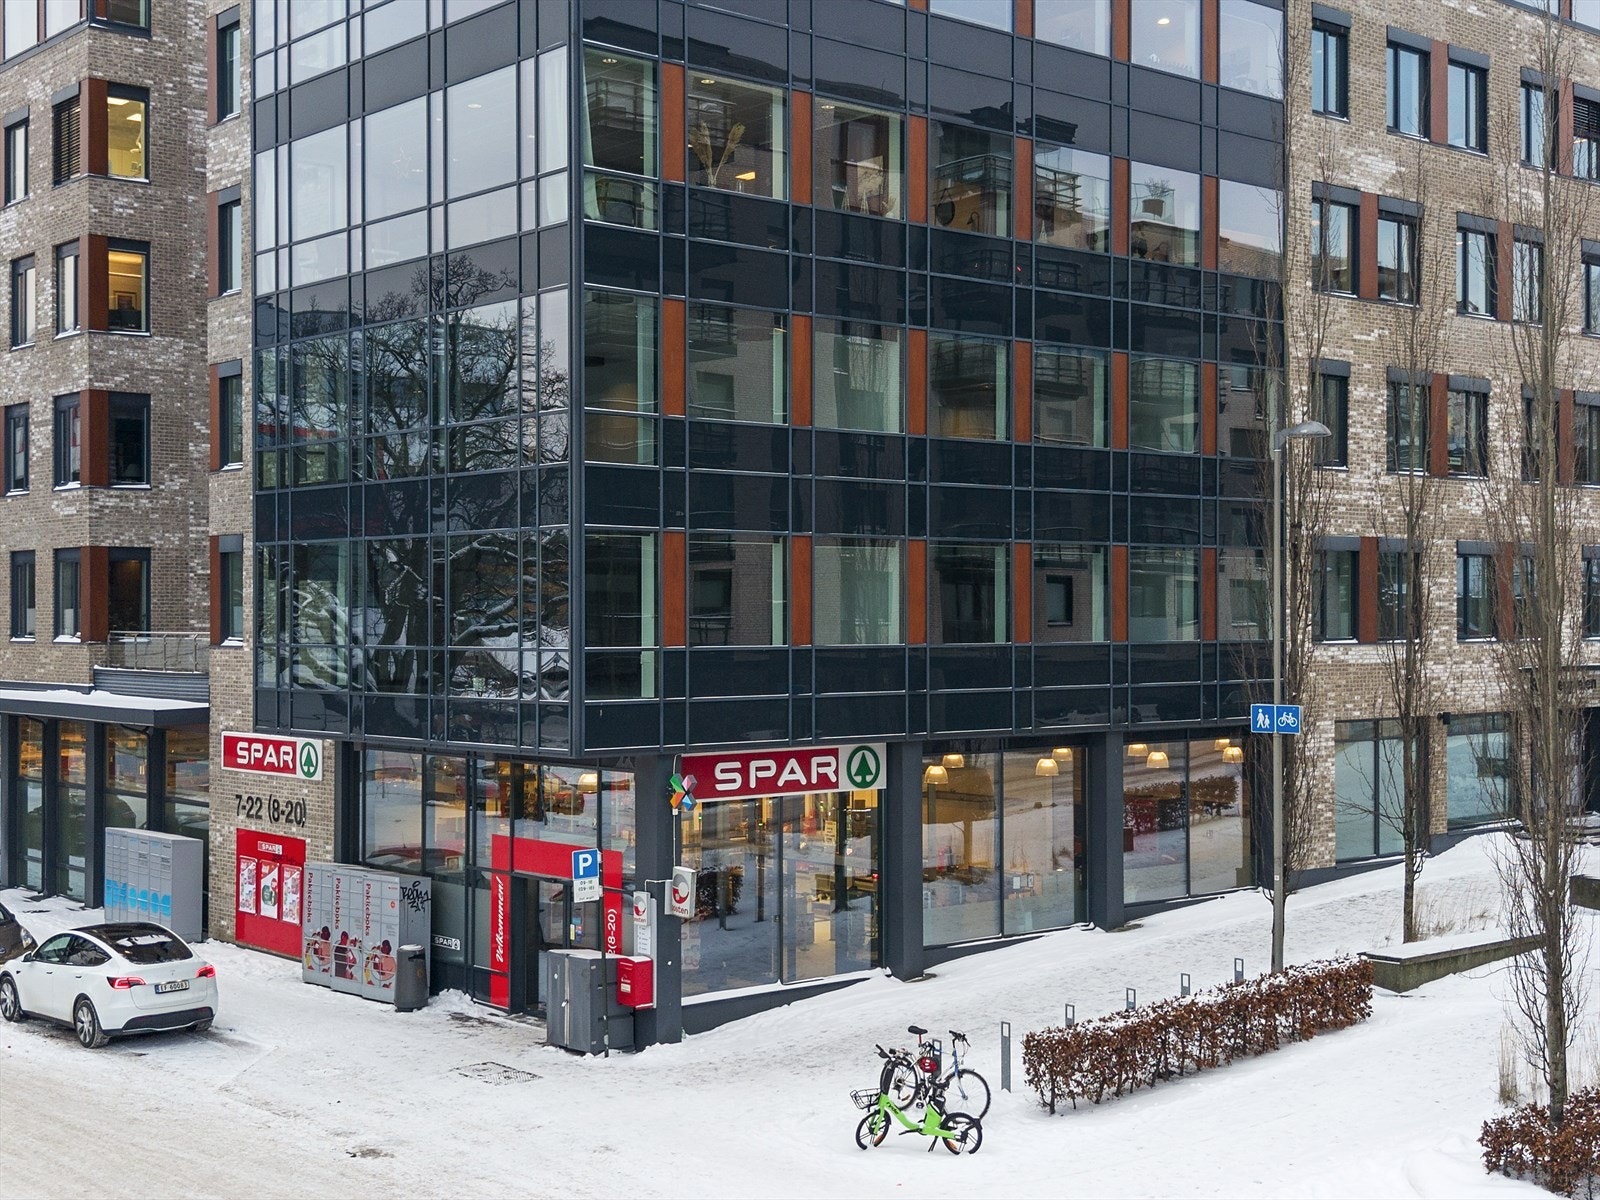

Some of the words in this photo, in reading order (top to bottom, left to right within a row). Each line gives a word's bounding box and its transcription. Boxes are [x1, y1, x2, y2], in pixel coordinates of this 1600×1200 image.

[236, 741, 293, 770] SPAR
[714, 755, 838, 791] SPAR
[235, 794, 263, 820] 7-22
[268, 794, 307, 828] (8-20)
[261, 843, 276, 852] SPAR
[578, 853, 593, 876] P
[495, 876, 504, 963] Velkommen!
[434, 936, 453, 946] SPAR
